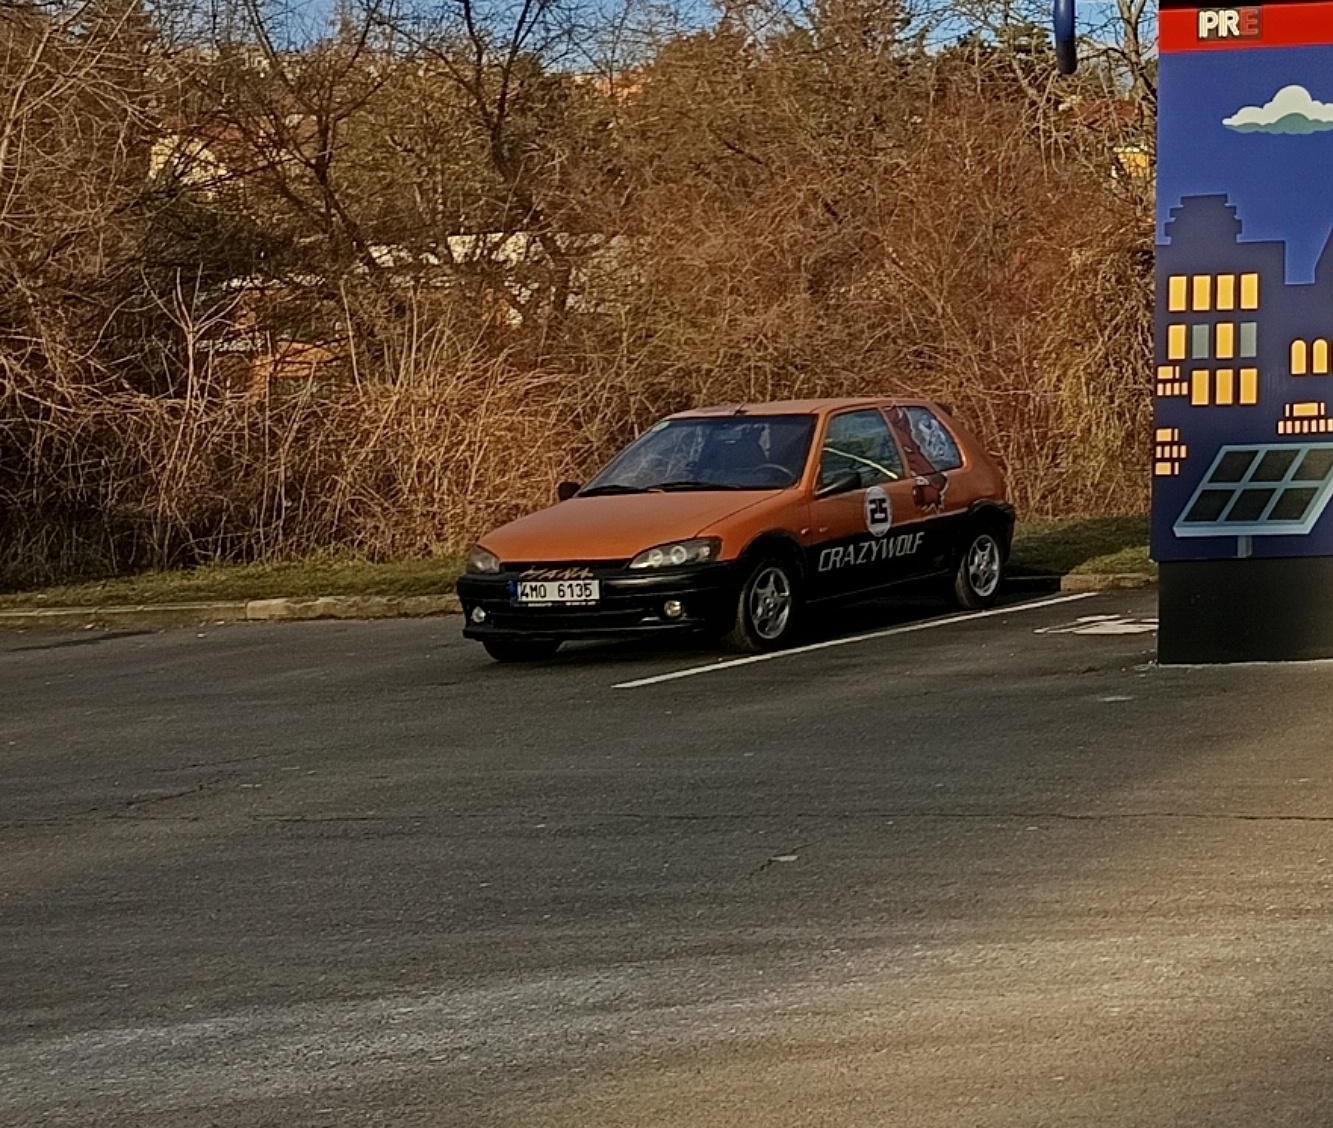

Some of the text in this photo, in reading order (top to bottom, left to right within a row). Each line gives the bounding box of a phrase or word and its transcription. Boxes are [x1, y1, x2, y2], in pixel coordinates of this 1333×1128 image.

[1198, 8, 1259, 39] PRE
[817, 531, 926, 573] CRAZYWOLF
[557, 583, 594, 599] 6135
